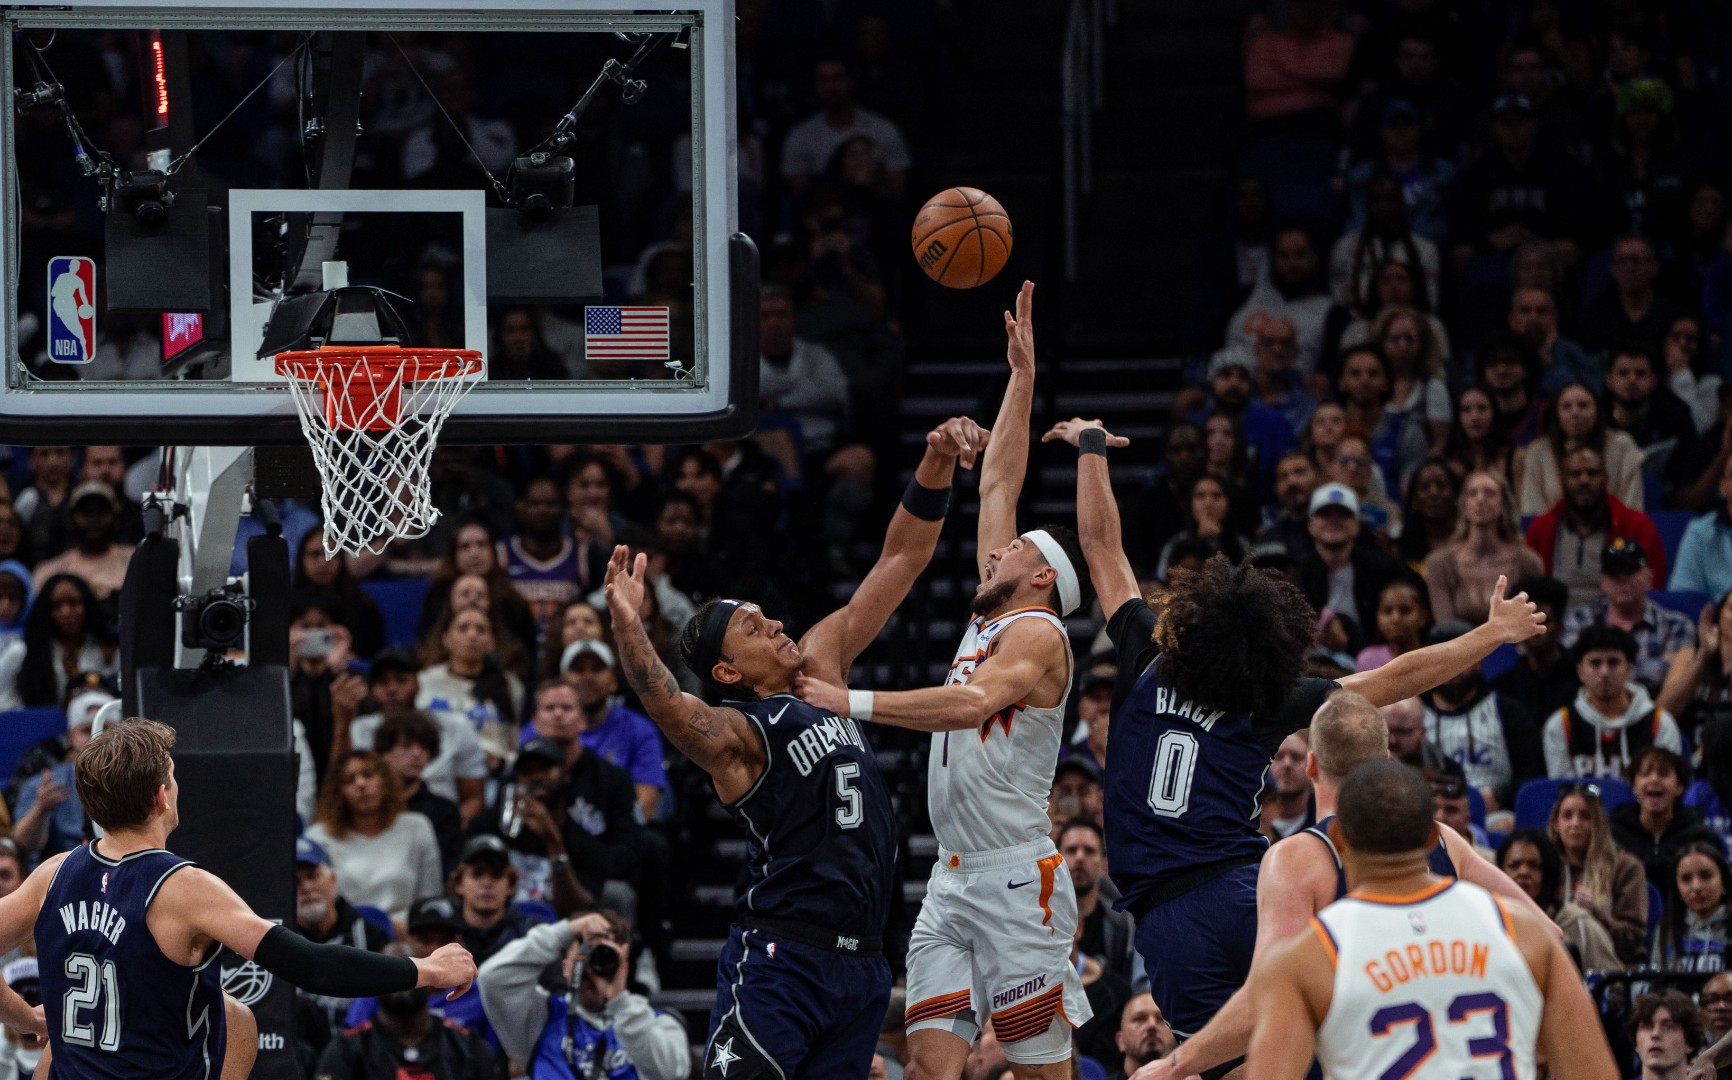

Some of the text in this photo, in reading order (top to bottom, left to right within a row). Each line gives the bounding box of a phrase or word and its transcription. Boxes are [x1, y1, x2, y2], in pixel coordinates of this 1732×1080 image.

[55, 339, 78, 356] NBA
[1156, 686, 1226, 733] BLACK
[834, 762, 864, 830] 5
[1147, 729, 1200, 819] 0
[58, 900, 126, 946] WAGNER
[992, 973, 1047, 1010] PHOENIX
[1364, 939, 1490, 994] GORDON
[61, 952, 122, 1052] 21
[1369, 991, 1519, 1080] 23
